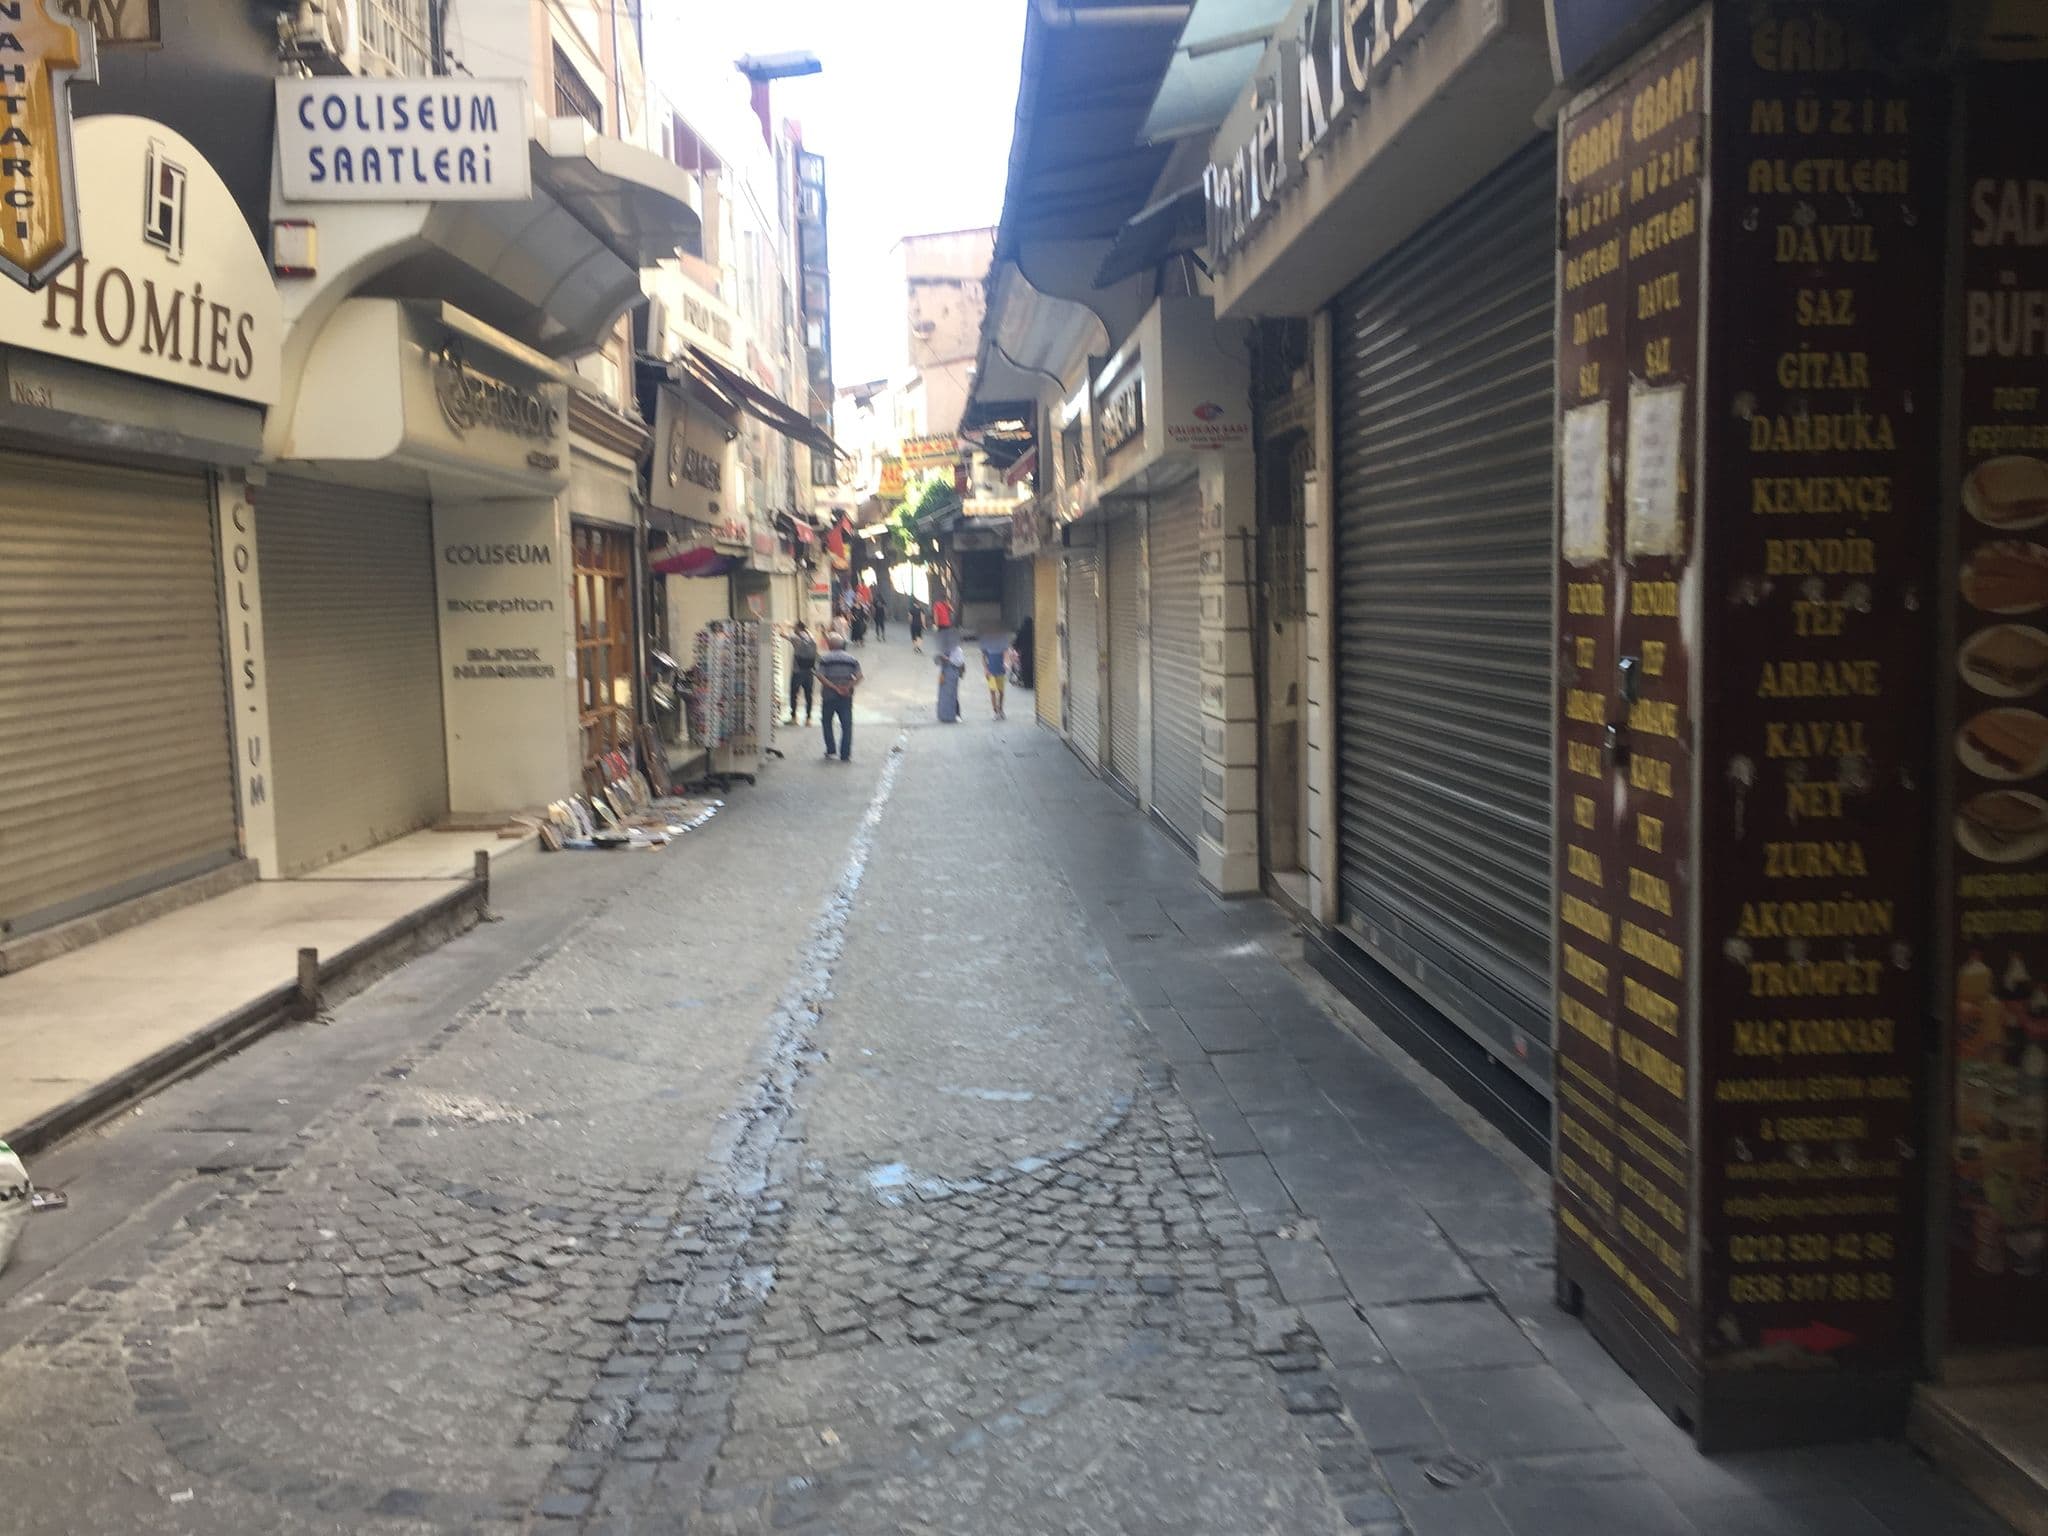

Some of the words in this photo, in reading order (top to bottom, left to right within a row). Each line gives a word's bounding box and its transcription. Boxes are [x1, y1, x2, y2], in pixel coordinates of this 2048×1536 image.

[298, 94, 499, 131] COLISEUM
[309, 145, 493, 184] SAATLERİ
[1775, 225, 1880, 263] DAVUL
[41, 257, 256, 381] HOMİES
[1795, 288, 1857, 328] SAZ
[1776, 342, 1872, 390] GİTAR
[1750, 412, 1896, 452] DARBUKA
[1752, 475, 1893, 520] KEMENÇE
[445, 543, 552, 565] COLISEUM
[1764, 721, 1869, 759] KAVAL
